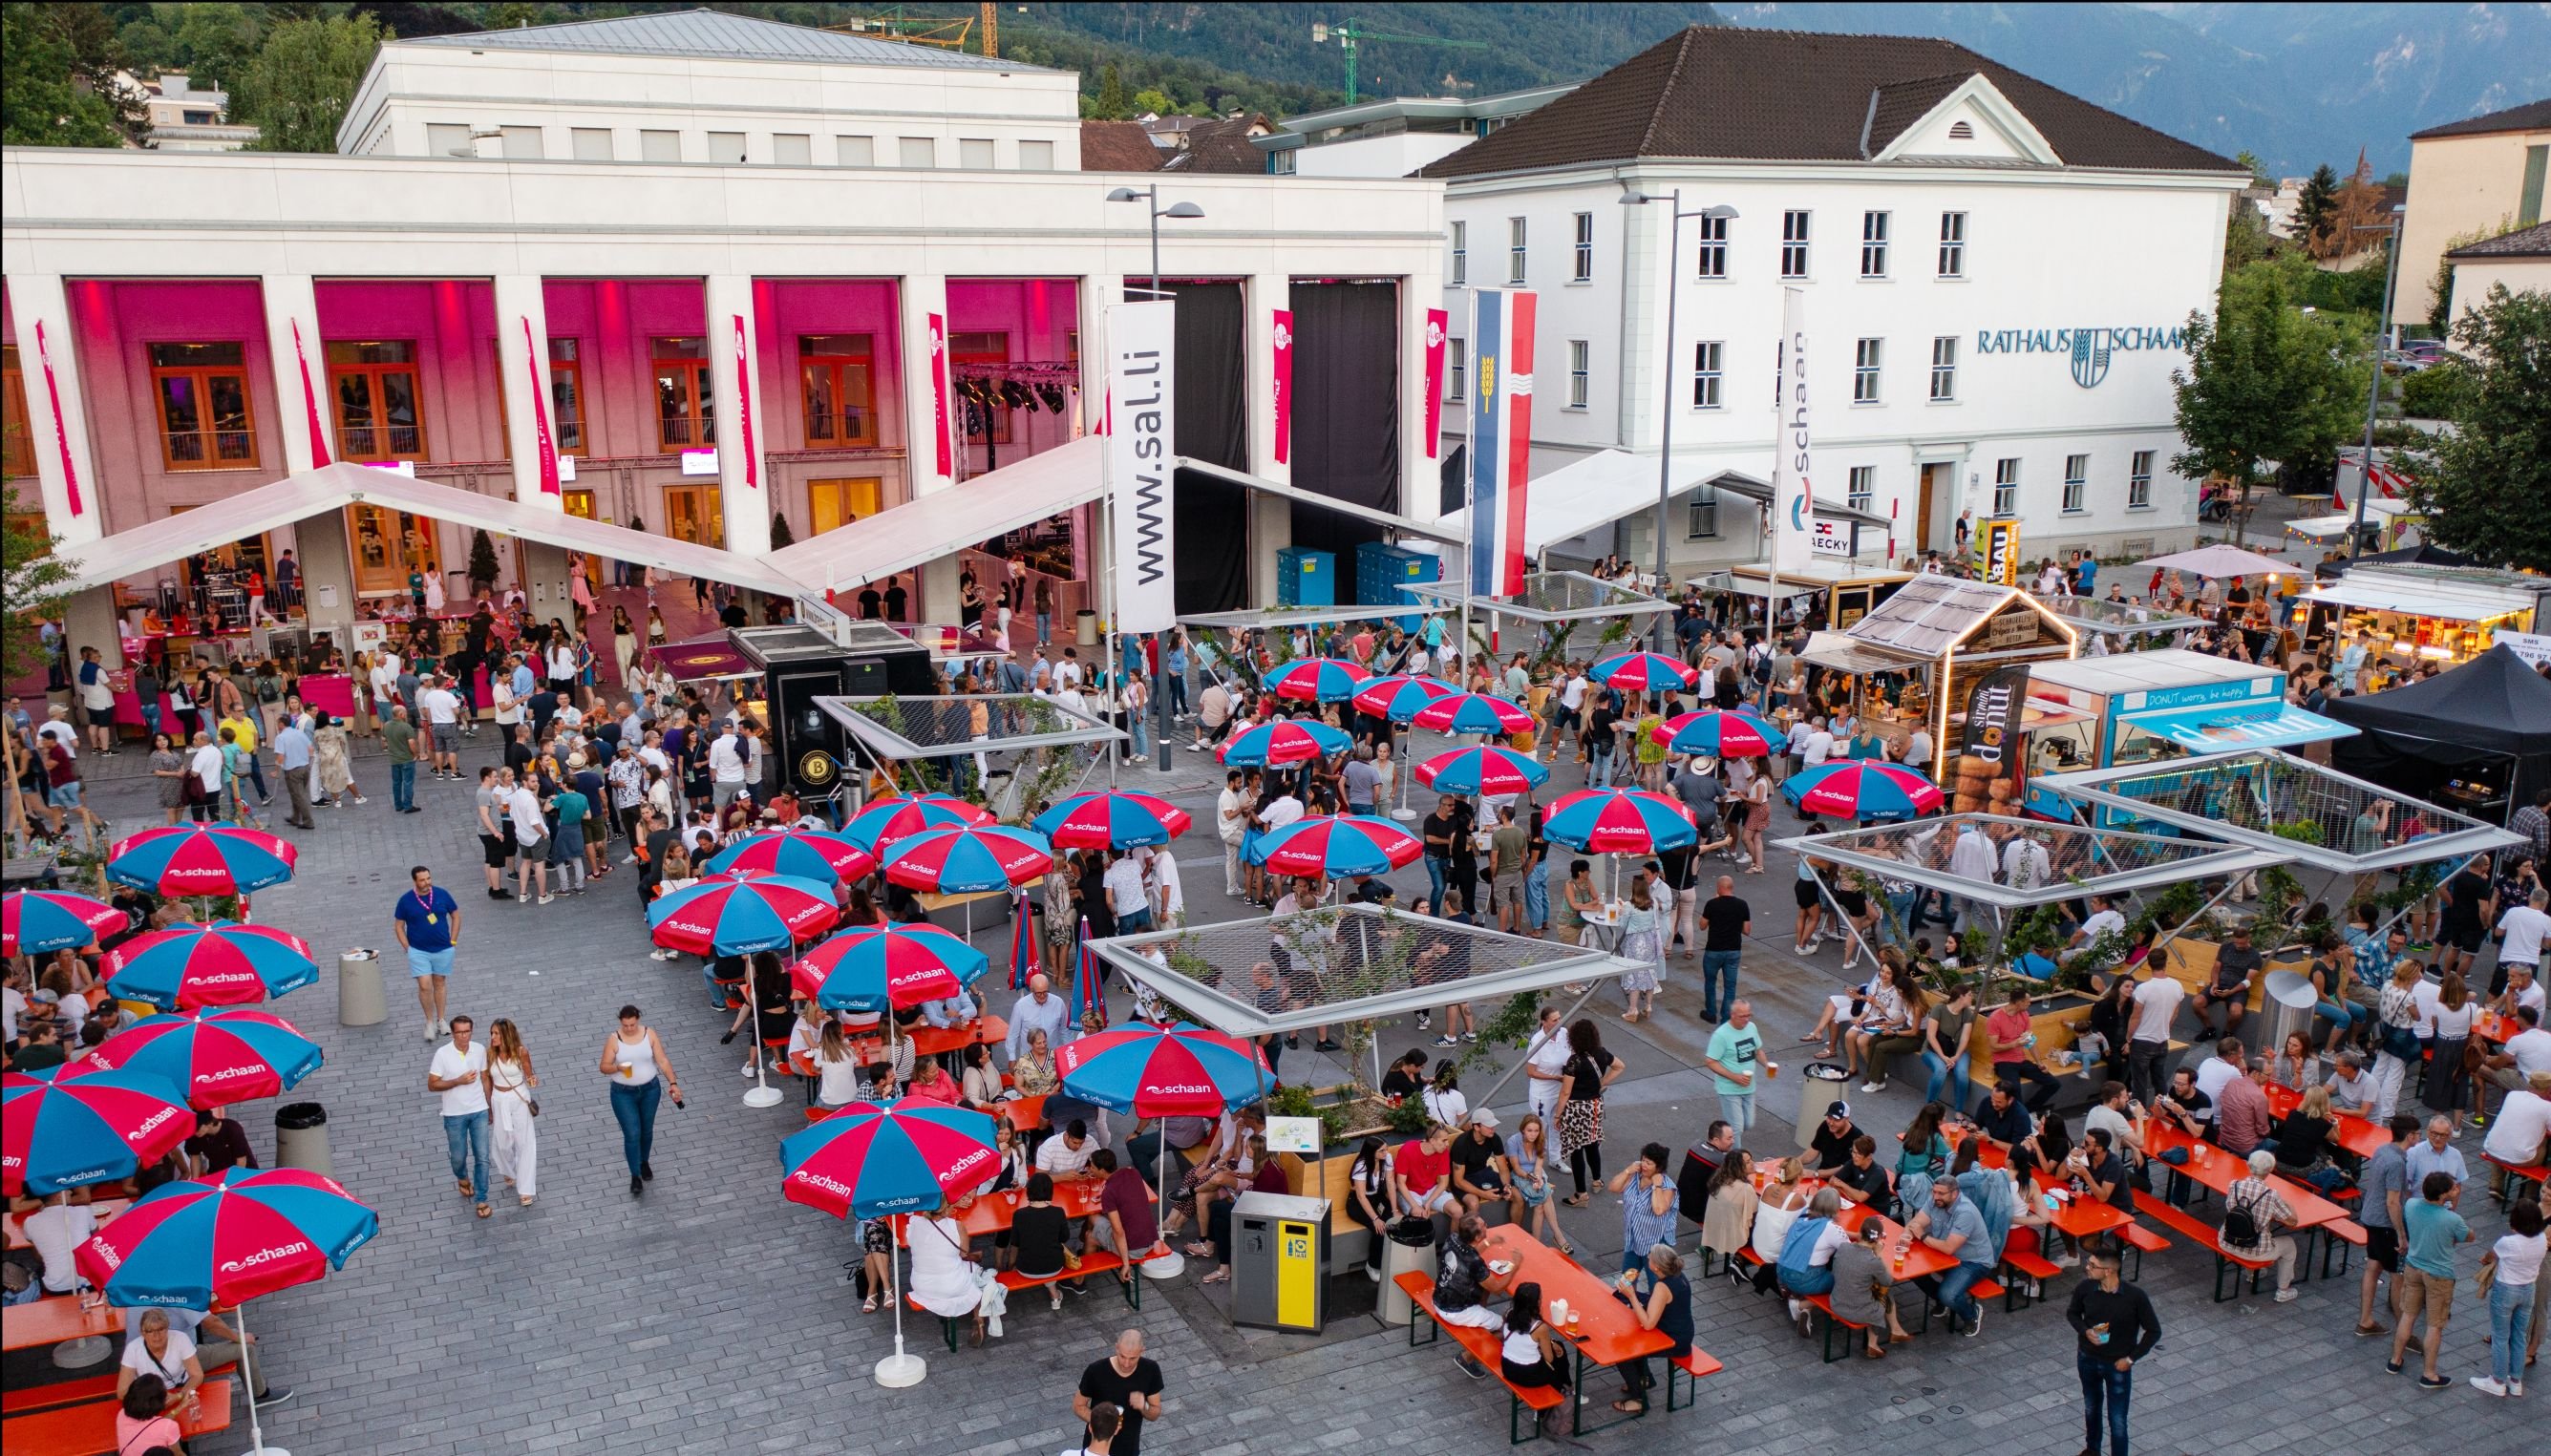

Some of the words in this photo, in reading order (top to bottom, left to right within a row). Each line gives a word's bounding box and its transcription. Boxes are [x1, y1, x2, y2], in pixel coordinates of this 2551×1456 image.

[1977, 328, 2072, 354] RATHAUS
[1789, 331, 1810, 473] schaan
[1123, 350, 1164, 586] www.sal.li
[1812, 537, 1848, 551] AECKY
[1293, 680, 1315, 688] schaan
[2149, 692, 2179, 706] DONUT
[2209, 687, 2220, 699] be
[2221, 686, 2246, 699] happy!
[1283, 738, 1313, 748] schaan
[1733, 734, 1760, 743] schaan
[1493, 774, 1523, 783] schaan
[1824, 791, 1855, 803] schaan
[1076, 824, 1108, 833] schaan
[1610, 826, 1646, 835] schaan
[840, 851, 863, 866] schaan
[1010, 853, 1040, 869] schaan
[1291, 852, 1322, 862] schaan
[185, 867, 225, 876] schaan
[908, 862, 937, 876] schaan
[797, 902, 826, 919] schaan
[679, 922, 712, 936] schaan
[207, 972, 254, 982] schaan
[807, 962, 826, 982] schaan
[906, 968, 946, 983] schaan
[216, 1064, 266, 1080] schaan
[1164, 1083, 1211, 1094] schaan
[140, 1106, 178, 1132] schaan
[950, 1148, 990, 1174] schaan
[71, 1170, 106, 1182] schaan
[810, 1173, 851, 1197] schaan
[888, 1196, 920, 1207] schaan
[98, 1243, 121, 1271] schaan
[245, 1241, 308, 1265] schaan
[153, 1295, 187, 1304] schaan
